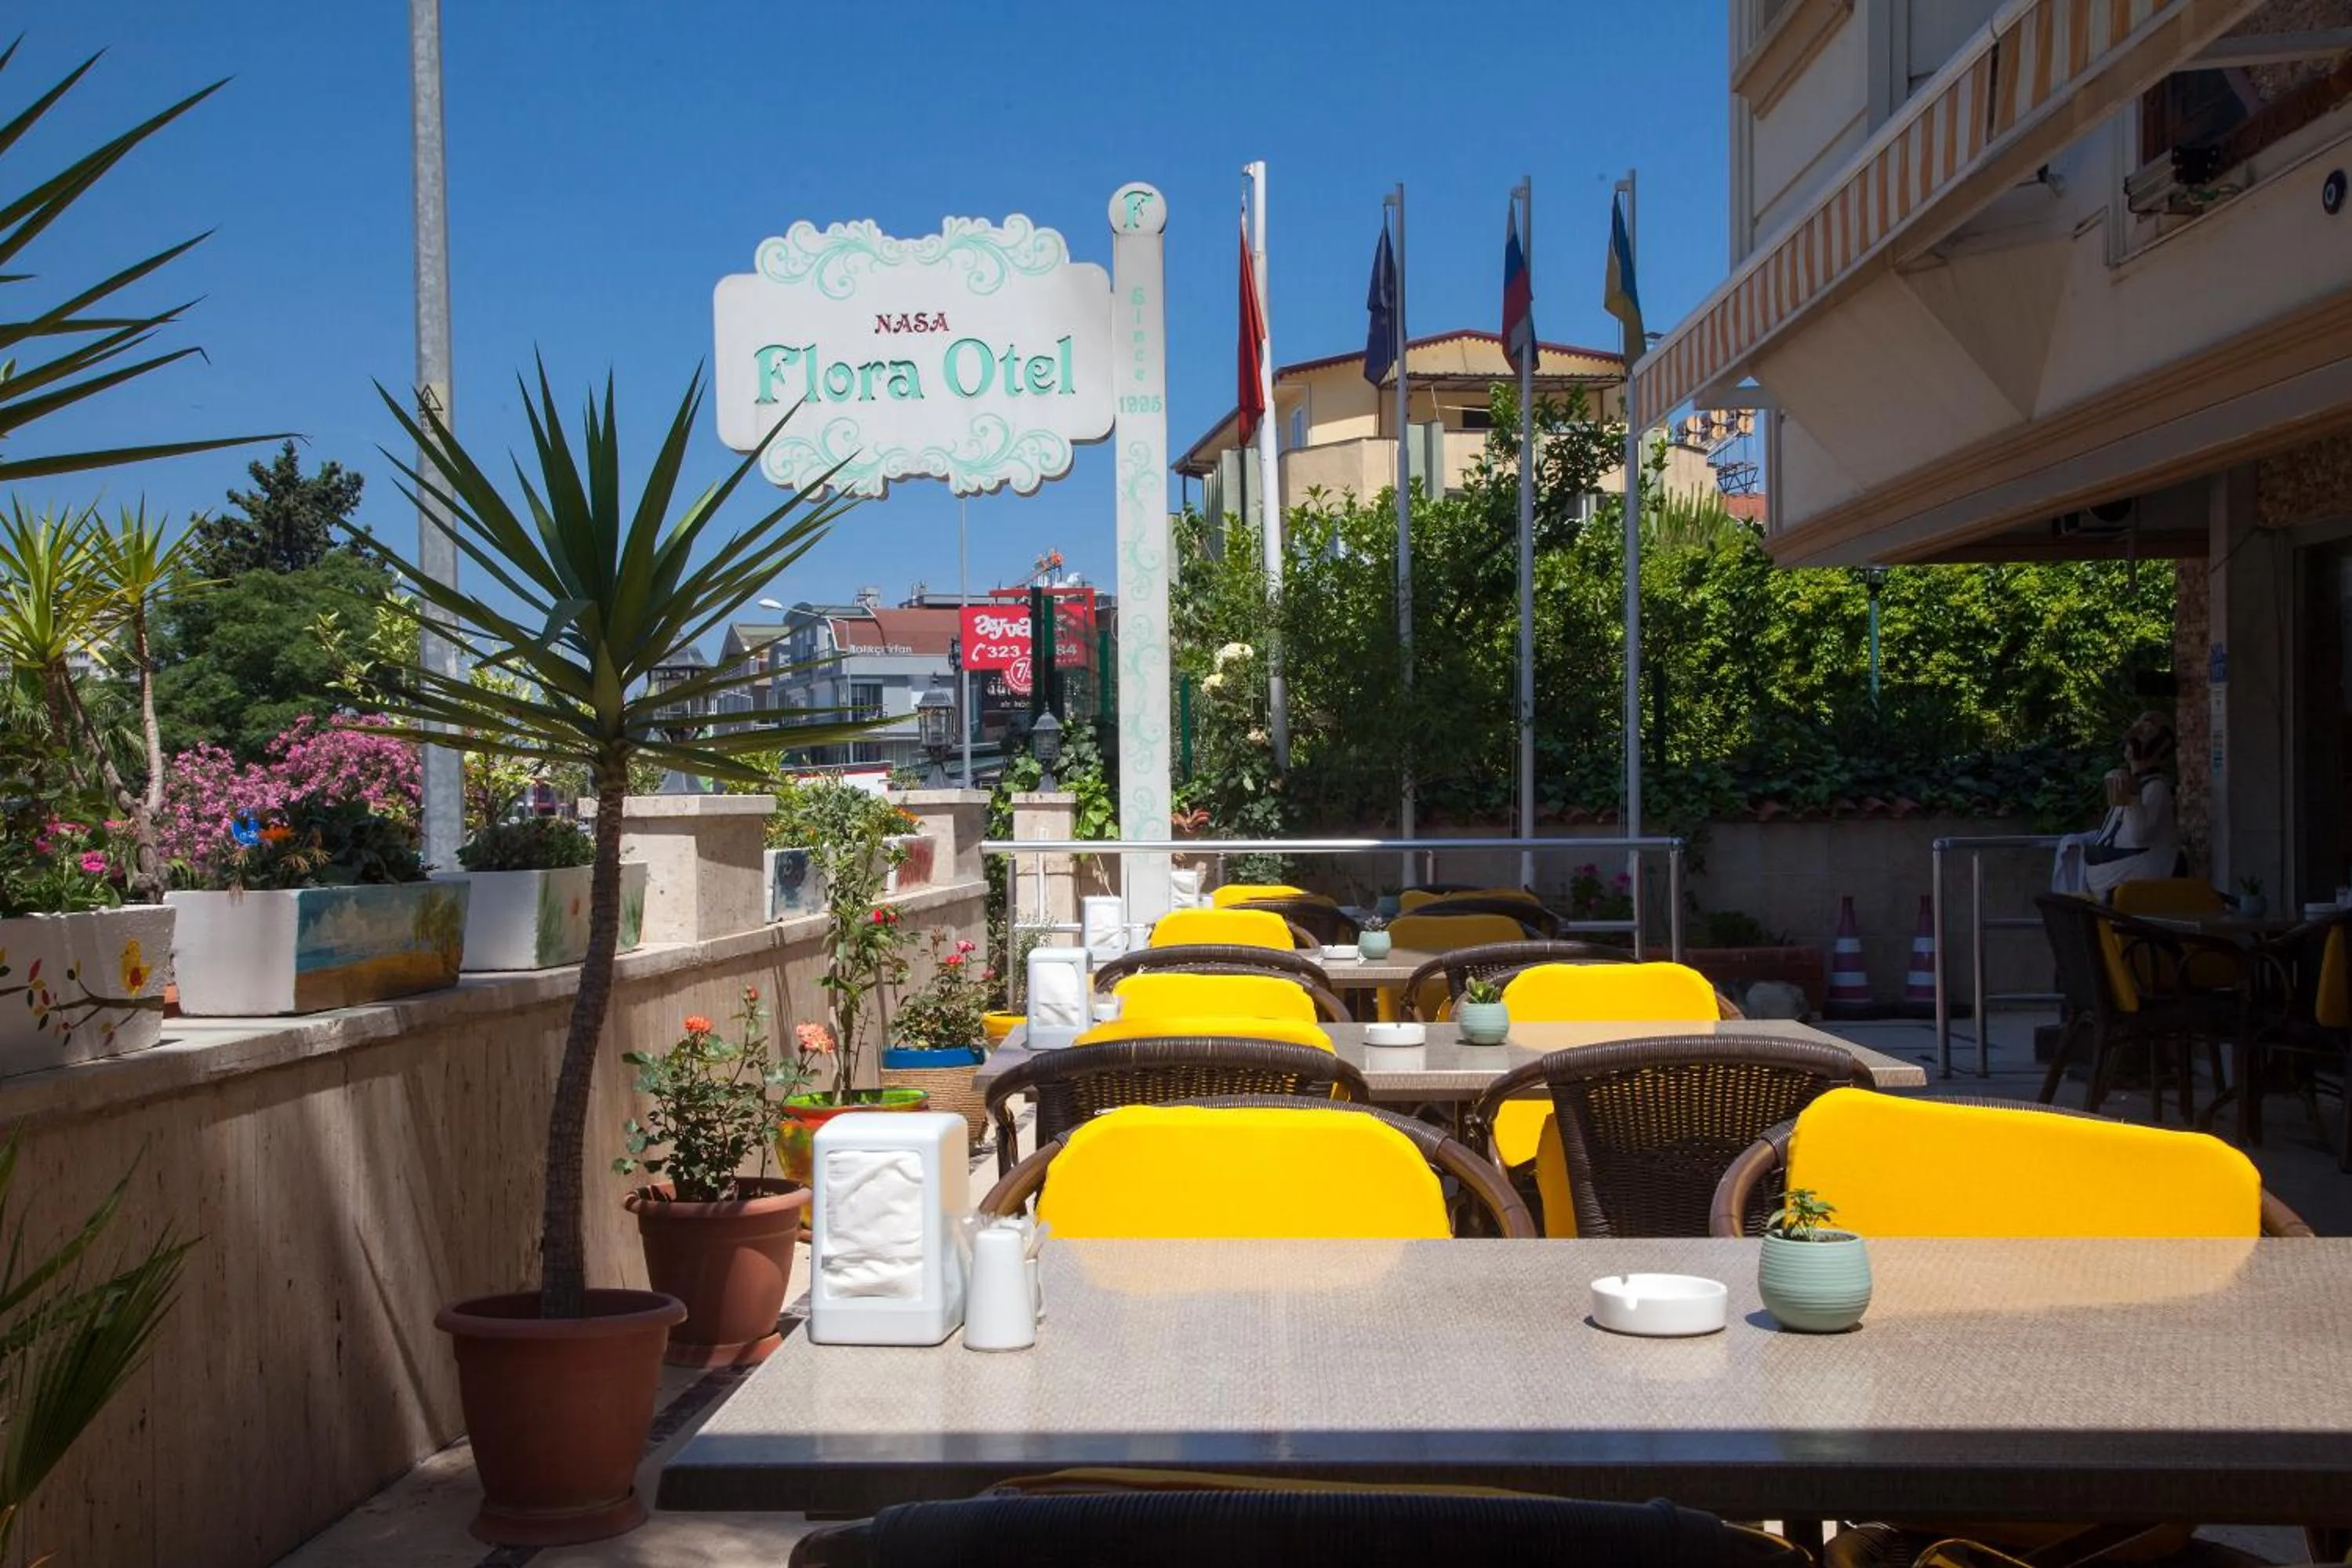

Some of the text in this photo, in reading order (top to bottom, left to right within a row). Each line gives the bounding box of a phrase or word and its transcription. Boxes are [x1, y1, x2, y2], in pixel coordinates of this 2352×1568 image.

[874, 312, 950, 334] NASA
[754, 335, 1076, 404] Flora Otel
[986, 645, 1021, 658] 323
